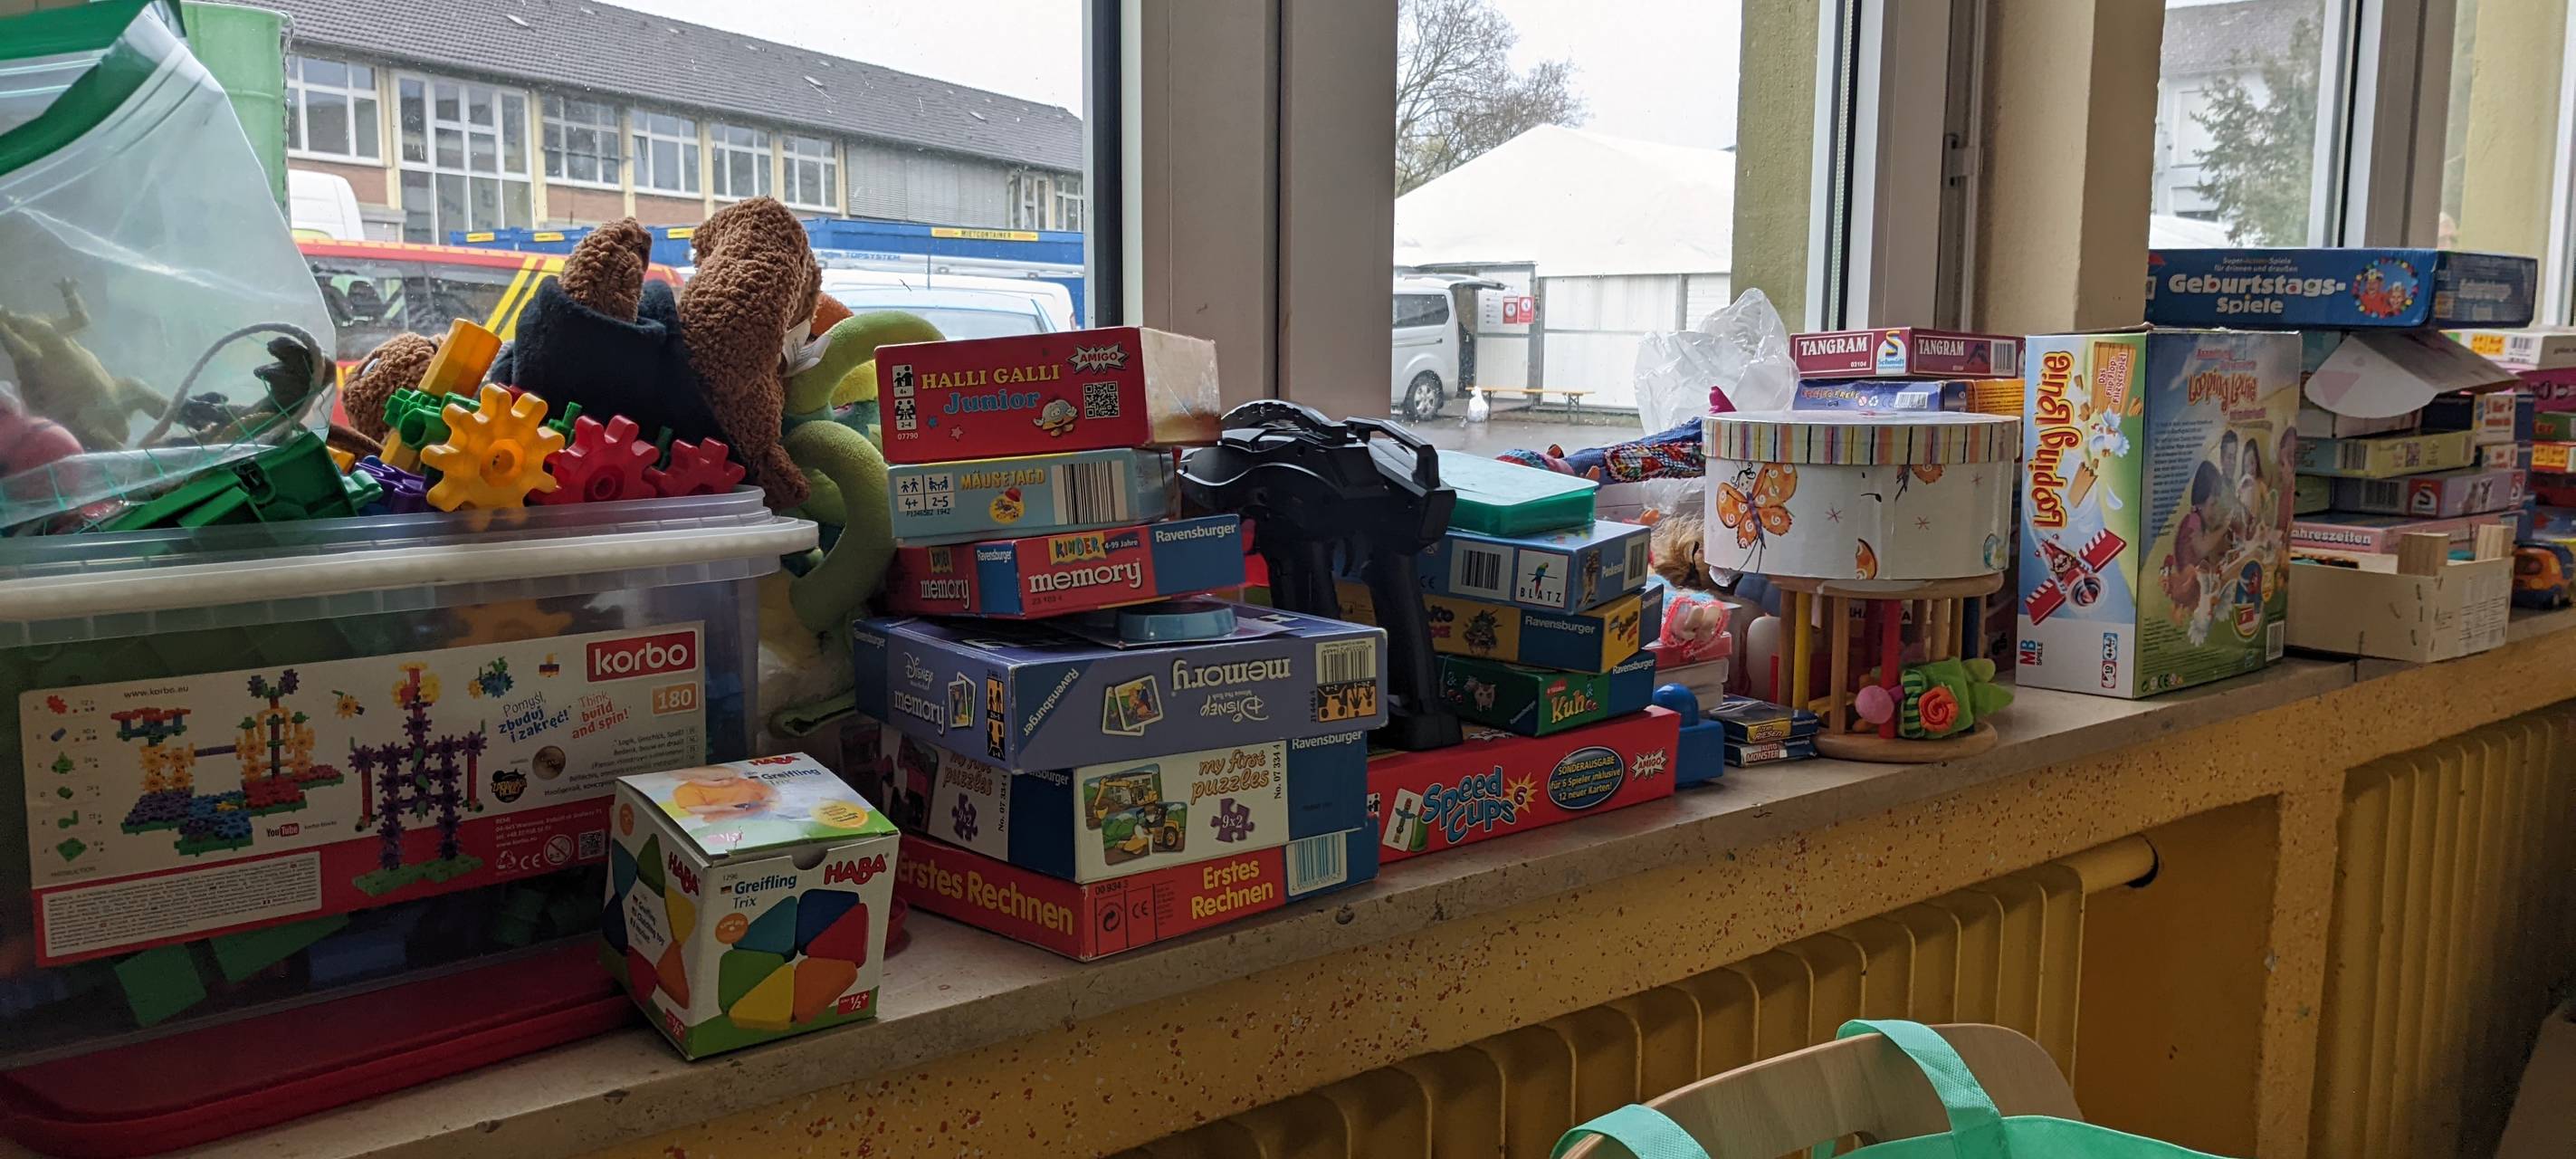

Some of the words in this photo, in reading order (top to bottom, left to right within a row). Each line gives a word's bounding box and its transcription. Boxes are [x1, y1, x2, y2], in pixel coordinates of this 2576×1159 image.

[2168, 273, 2346, 297] Geburtstags-
[2216, 294, 2284, 314] Spiele
[1079, 351, 1119, 362] AMIGO
[1800, 337, 1867, 356] TANGRAM
[1918, 339, 1965, 356] TANGRAM
[921, 369, 987, 389] HALLI
[992, 364, 1062, 384] GALLI
[2097, 369, 2106, 384] Das
[2034, 353, 2074, 426] Louie
[943, 388, 1042, 415] Junior
[897, 432, 919, 441] 07790
[960, 468, 1046, 490] MÄUSEJAGD
[2027, 429, 2081, 529] Looping
[904, 497, 918, 508] 4+
[931, 496, 949, 507] 2-5
[1155, 524, 1236, 542] Ravensburger
[2291, 529, 2371, 545] ahreszeiten
[977, 547, 1013, 563] Ravensburger
[1055, 537, 1101, 559] KINDER
[1104, 541, 1120, 551] 4-99
[1121, 539, 1139, 549] Jahre
[1028, 558, 1142, 594] memory
[921, 573, 970, 609] memory
[1521, 587, 1561, 603] BLATZ
[1525, 616, 1596, 635] Ravensburger
[594, 642, 689, 675] korbo
[2019, 639, 2036, 666] MB
[1171, 657, 1291, 693] memory
[1612, 659, 1655, 675] Ravensburger
[579, 690, 610, 709] Think
[657, 689, 692, 710] 180
[1023, 668, 1080, 736] Ravensburger
[1550, 689, 1586, 724] Kuh
[499, 706, 544, 734] zbuduj
[581, 700, 614, 723] build
[894, 691, 945, 735] memory
[510, 732, 516, 742] i
[572, 724, 596, 739] and
[1292, 731, 1363, 750] Ravensburger
[1746, 751, 1779, 762] MONSTER
[1760, 743, 1778, 752] AUTO
[749, 755, 801, 766] HABA
[1199, 757, 1226, 776] my
[1228, 749, 1266, 773] first
[1558, 755, 1616, 776] SONDERAUSGABE
[1637, 757, 1662, 770] AMIGO
[761, 769, 822, 781] Greifling
[942, 766, 993, 796] puzzles
[1273, 771, 1281, 782] 07
[1550, 781, 1561, 791] für
[1562, 778, 1567, 787] 6
[1568, 774, 1591, 789] Spieler
[1592, 769, 1622, 781] inklusive
[1191, 769, 1269, 806] puzzles
[1512, 786, 1527, 806] 6
[1559, 791, 1567, 801] 12
[1568, 789, 1587, 799] neuer
[1589, 781, 1613, 796] Karten!
[1421, 765, 1503, 831] Speed
[1222, 815, 1243, 829] 9x2
[1446, 799, 1517, 845] Cups
[667, 851, 700, 896] HABA
[824, 854, 887, 886] HABA
[1203, 860, 1260, 890] Erstes
[734, 875, 797, 895] Greifling
[897, 853, 963, 898] Erstes
[968, 870, 1073, 934] Rechnen
[733, 896, 758, 909] Trix
[1191, 882, 1274, 920] Rechnen
